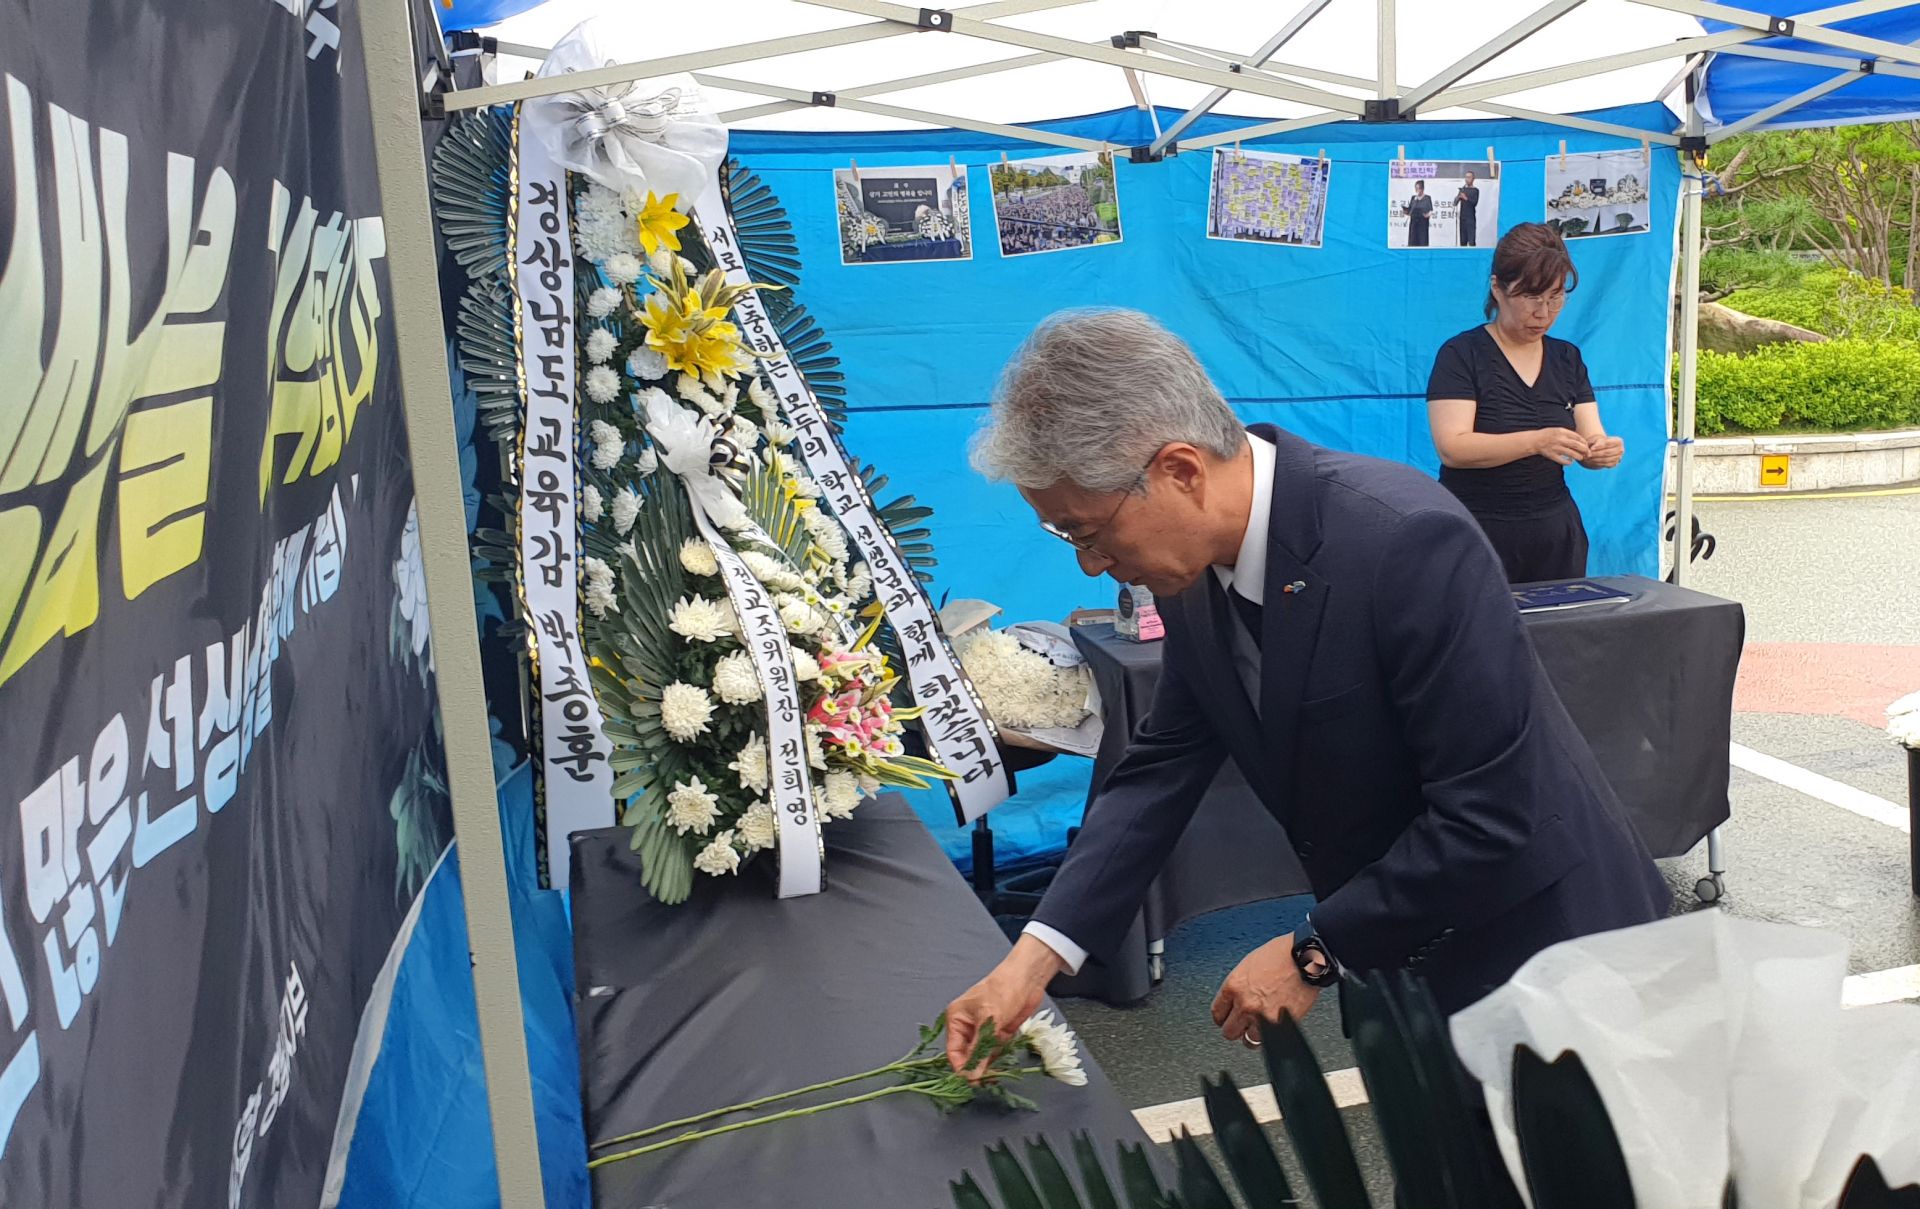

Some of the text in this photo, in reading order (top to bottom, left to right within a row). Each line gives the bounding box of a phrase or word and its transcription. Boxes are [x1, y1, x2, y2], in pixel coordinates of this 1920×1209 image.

[521, 179, 606, 783] 경상남도교육감 박종훈
[711, 226, 1001, 784] 서로 존중하는 모두의 학교 선생님과 함께 하겠습니다
[779, 738, 808, 826] 전희영
